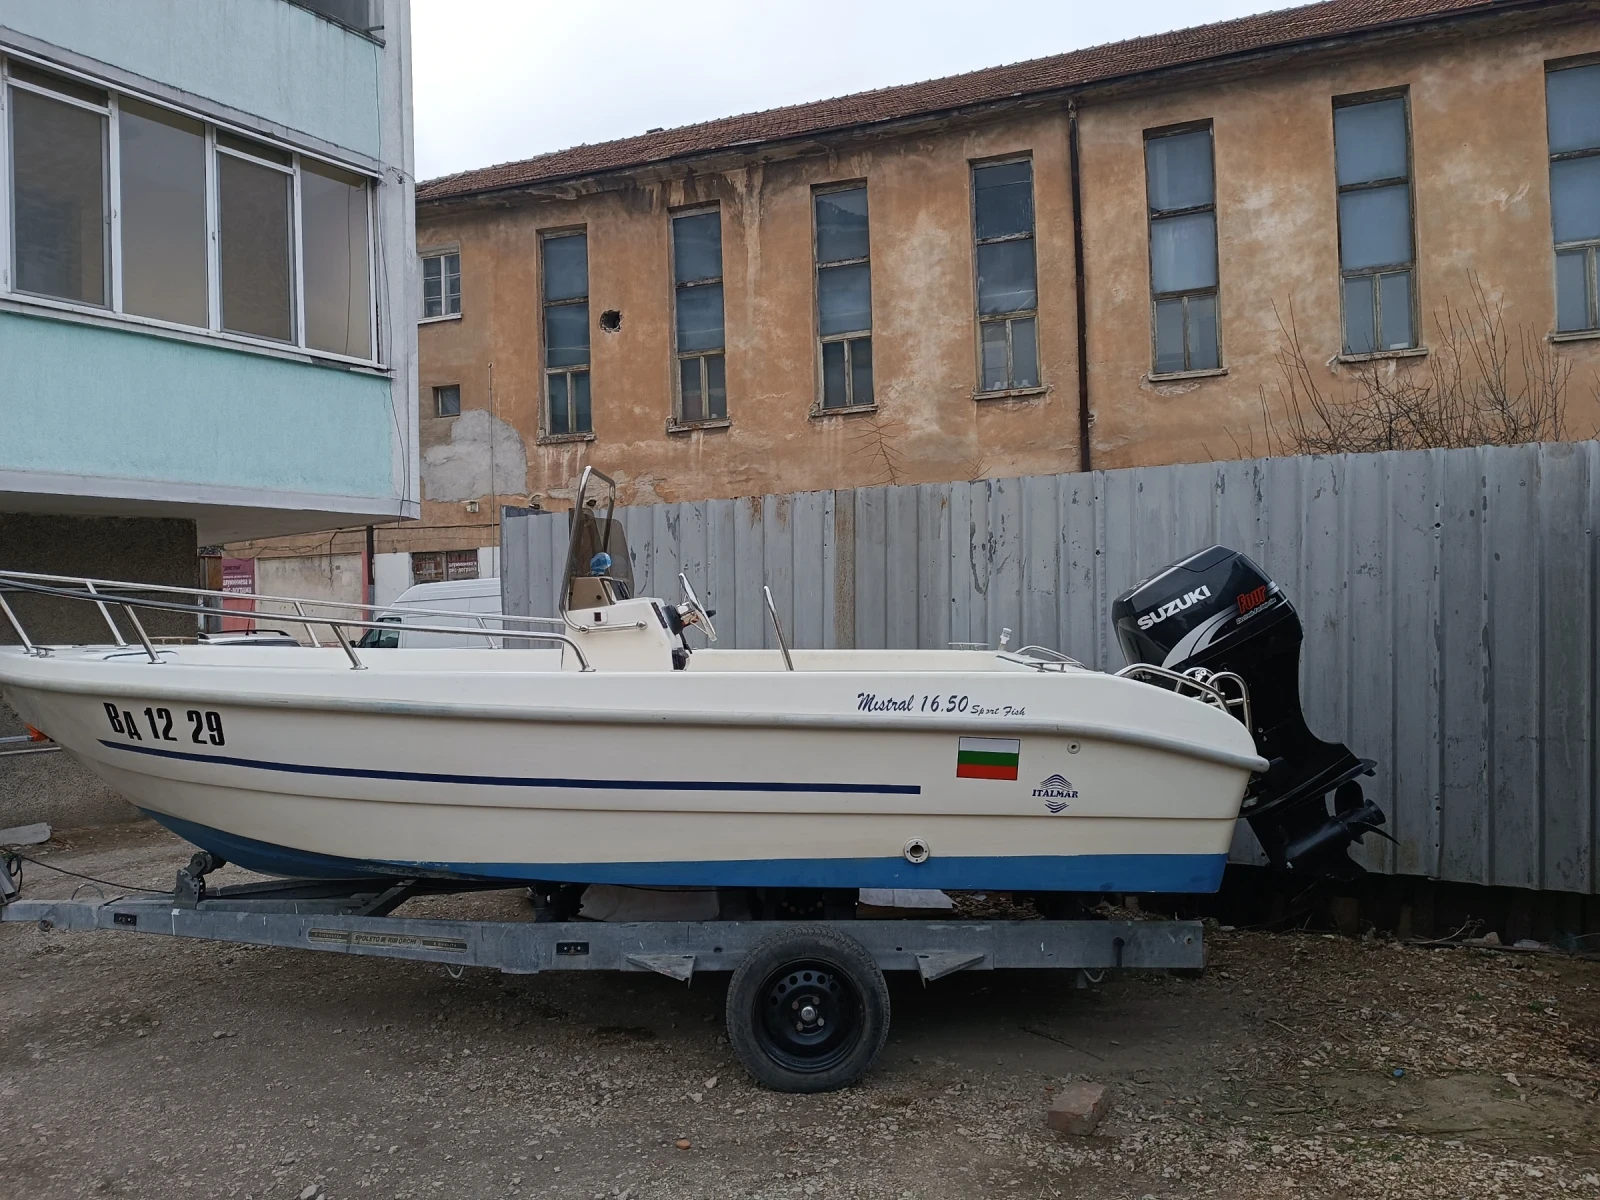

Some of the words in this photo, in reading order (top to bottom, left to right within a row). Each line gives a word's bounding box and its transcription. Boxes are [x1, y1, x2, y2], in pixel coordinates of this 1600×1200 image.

[1137, 585, 1211, 630] SUZUKI
[857, 692, 914, 712] Mistral
[920, 695, 969, 712] 16.50
[970, 705, 999, 717] Sport
[1002, 706, 1026, 717] Fish
[144, 707, 178, 741] 12
[187, 710, 225, 746] 29
[1032, 789, 1078, 798] ITALMAR
[355, 935, 380, 943] SPOLETO
